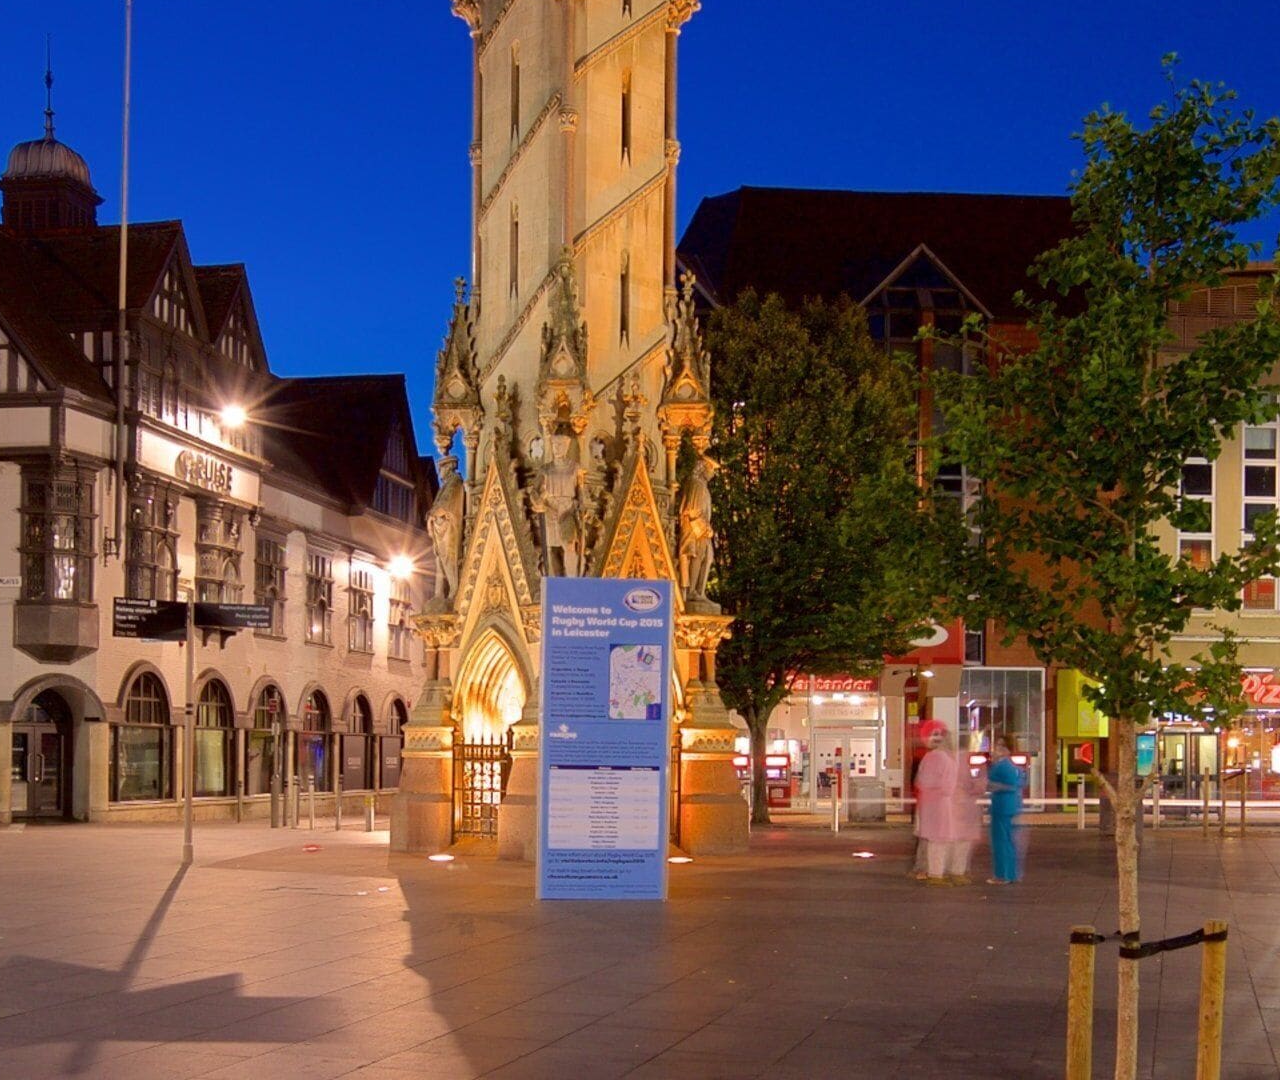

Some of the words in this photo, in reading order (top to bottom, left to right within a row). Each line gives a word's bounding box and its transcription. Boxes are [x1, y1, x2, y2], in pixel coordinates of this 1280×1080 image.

[552, 605, 598, 615] Welcome
[601, 606, 612, 615] to
[552, 617, 585, 627] Rugby
[586, 617, 617, 626] World
[619, 618, 638, 628] Cup
[639, 618, 664, 628] 2015
[552, 628, 561, 636] in
[563, 629, 610, 638] Leicester
